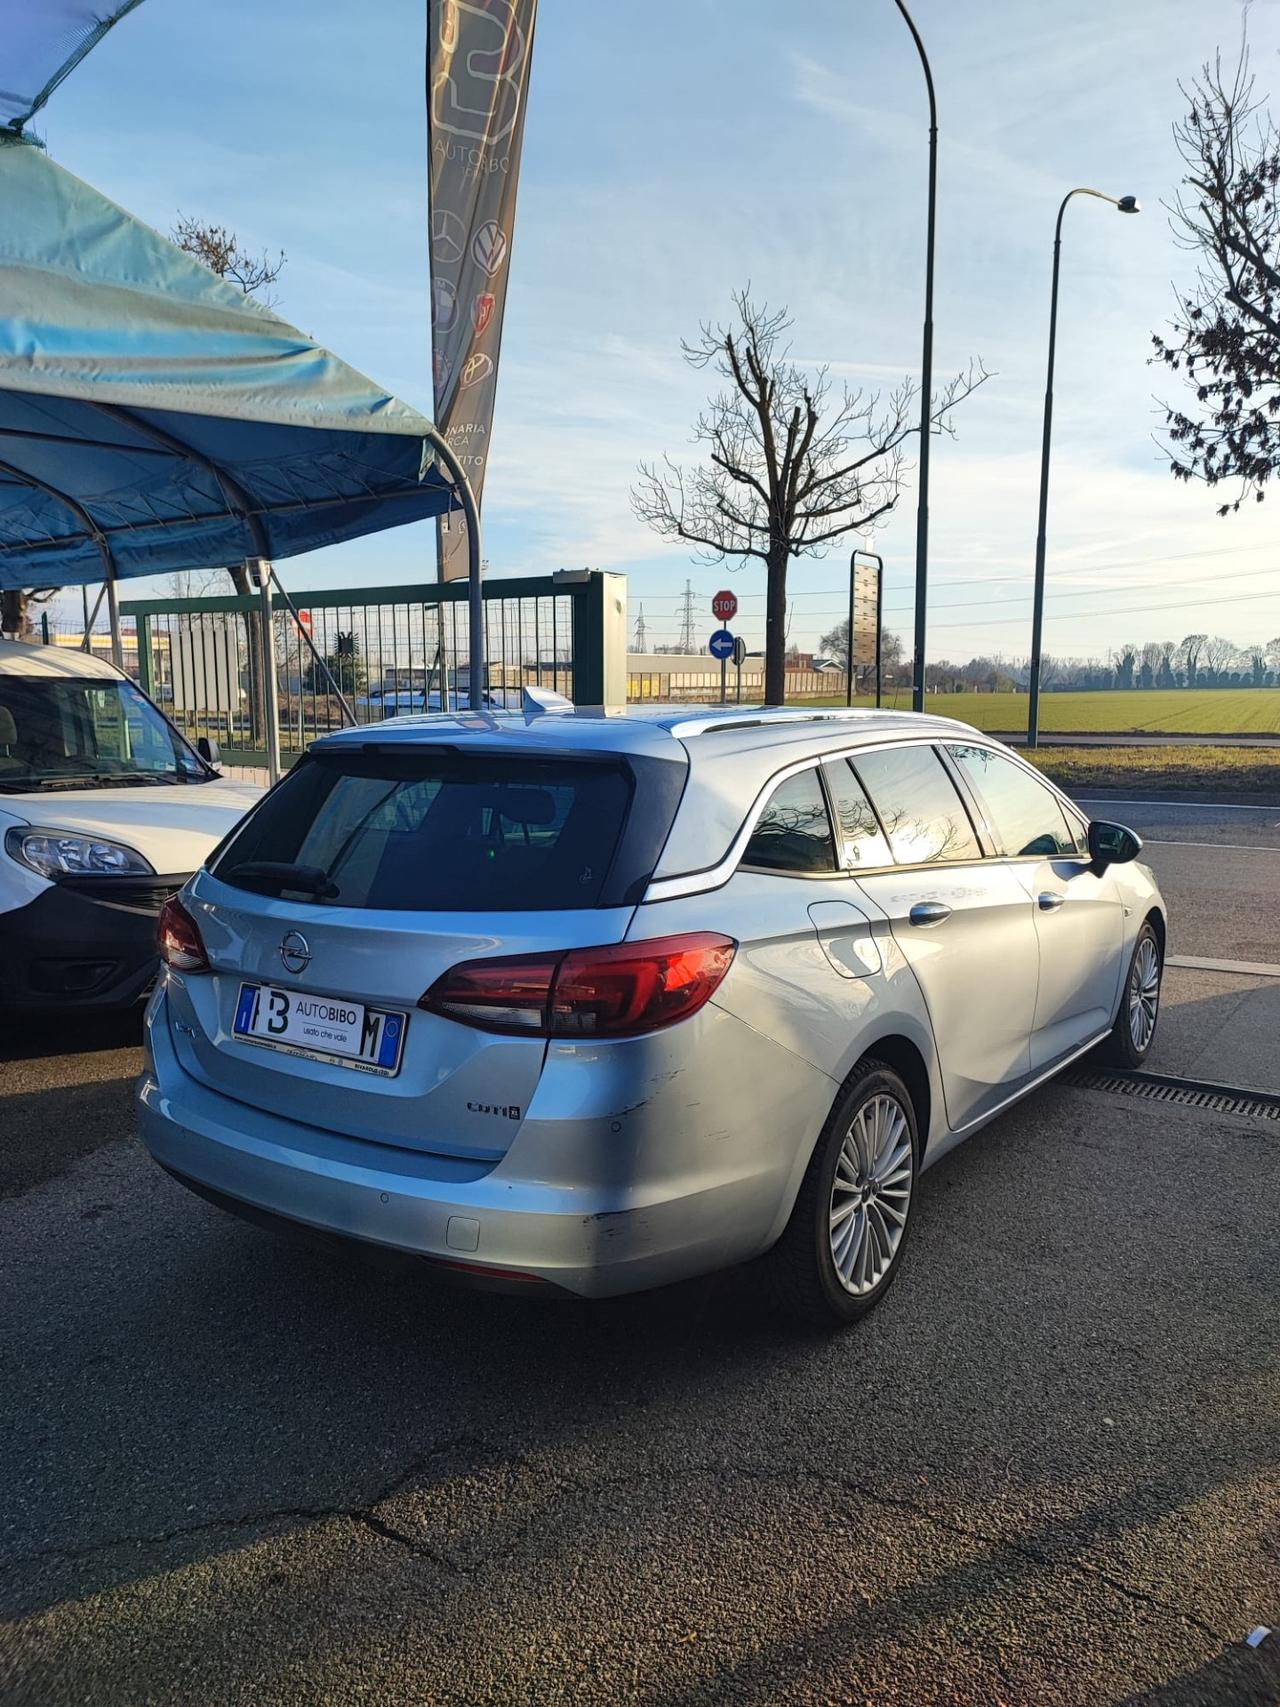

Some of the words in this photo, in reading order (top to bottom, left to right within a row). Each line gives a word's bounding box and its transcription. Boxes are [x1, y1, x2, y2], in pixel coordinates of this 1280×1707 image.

[448, 436, 469, 446] RCA
[714, 600, 735, 611] STOP
[295, 1000, 357, 1025] AUTOBIBO
[303, 1026, 320, 1039] usato
[320, 1028, 333, 1041] che
[333, 1030, 348, 1043] vale
